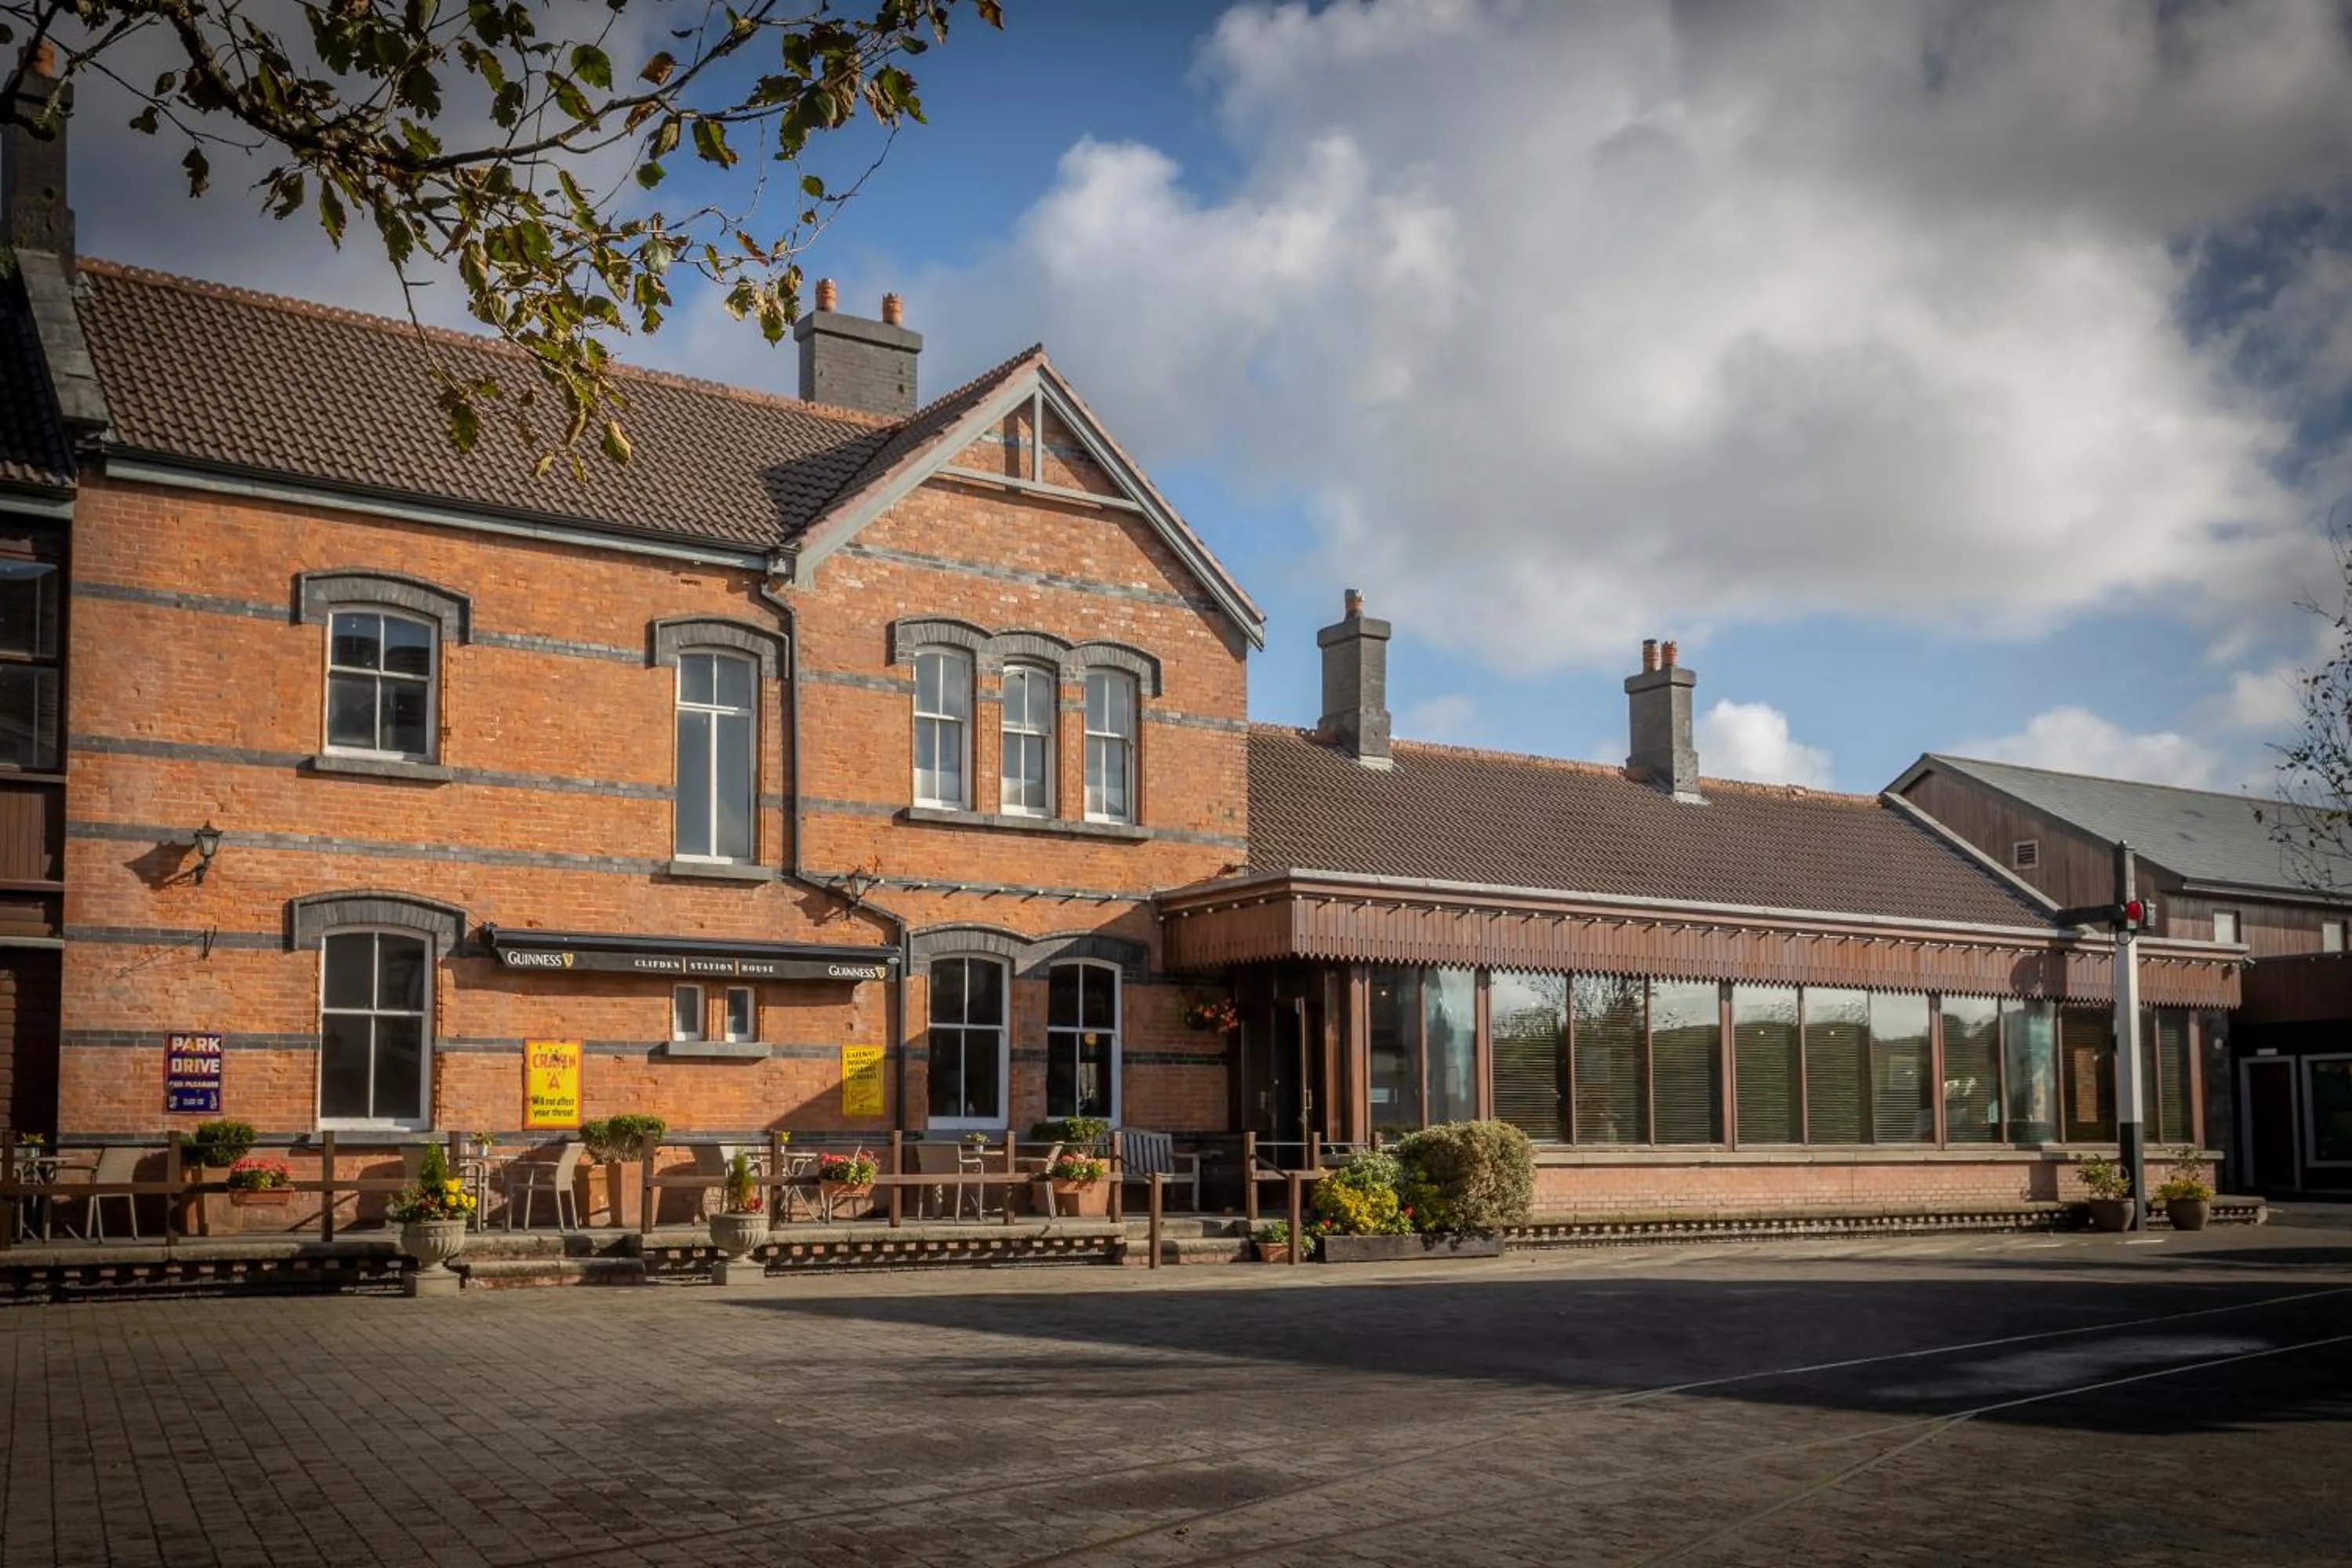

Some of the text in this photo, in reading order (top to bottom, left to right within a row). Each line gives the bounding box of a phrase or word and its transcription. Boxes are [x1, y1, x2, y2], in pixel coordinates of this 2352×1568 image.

[507, 951, 562, 967] GUINNESS
[634, 959, 774, 973] CLIFDEN STATION HOUSE
[829, 965, 876, 978] GUINNESS
[172, 1037, 220, 1052] PARK
[171, 1058, 220, 1073] DRIVE
[549, 1073, 560, 1089] A
[533, 1109, 550, 1120] your
